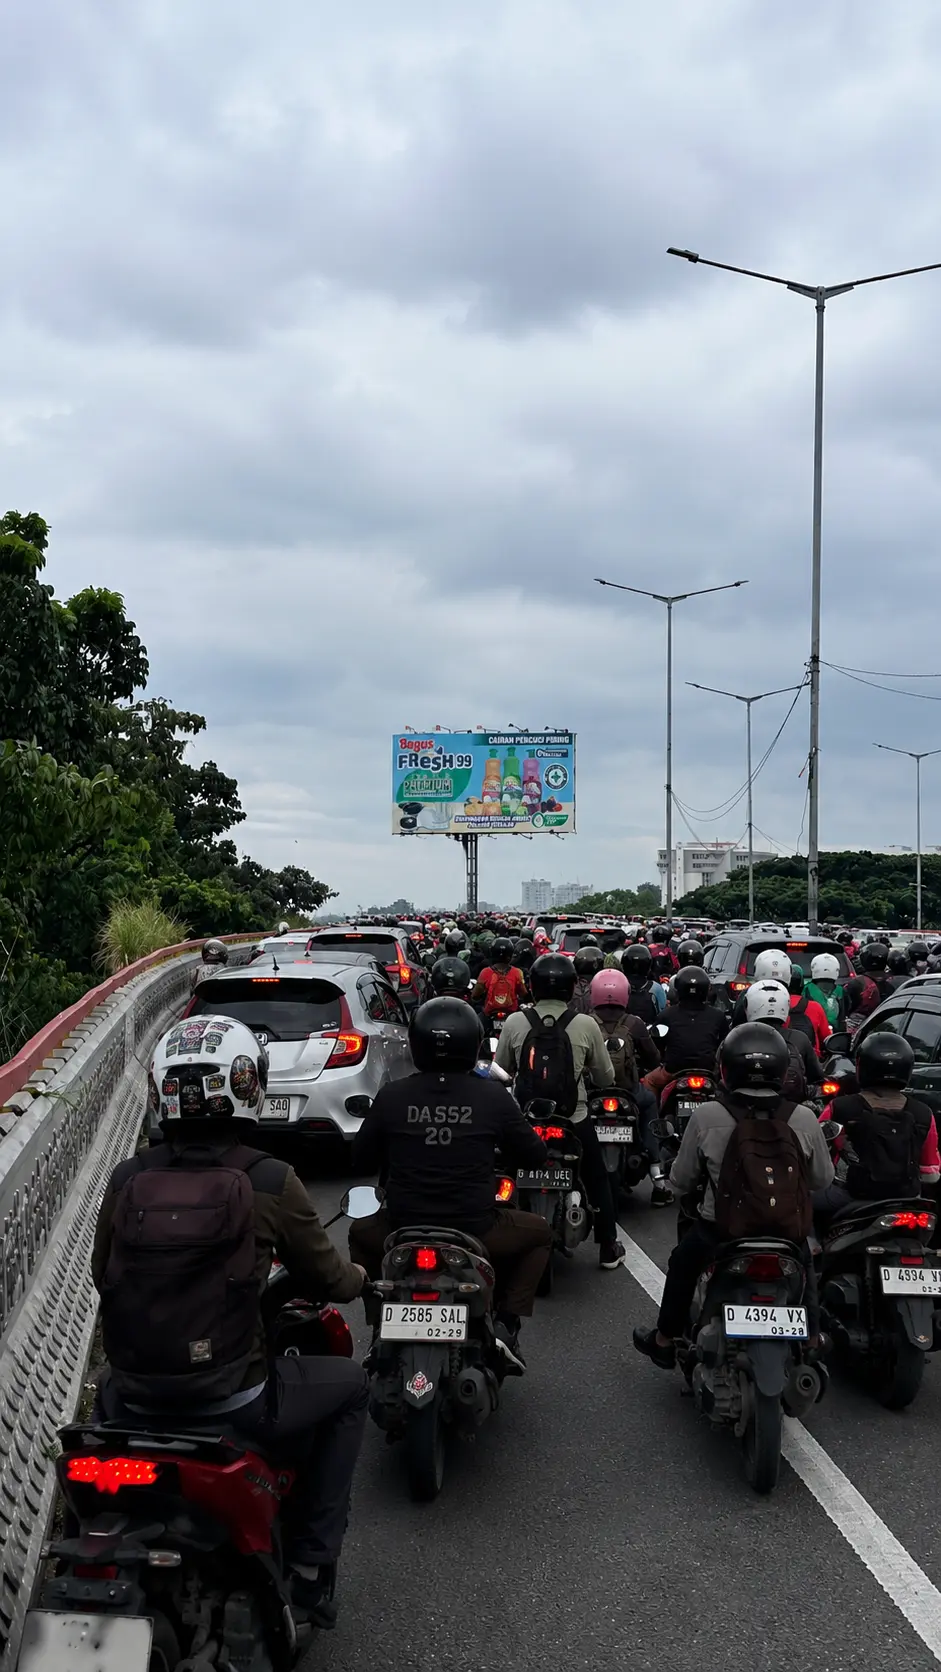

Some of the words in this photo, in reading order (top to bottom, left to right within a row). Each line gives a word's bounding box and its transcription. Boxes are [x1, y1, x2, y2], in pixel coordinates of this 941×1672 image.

[399, 738, 434, 752] Bagus
[457, 755, 472, 768] 99
[424, 1126, 452, 1145] 20
[883, 1268, 890, 1281] D
[385, 1307, 393, 1322] D
[401, 1307, 433, 1323] 2585
[440, 1308, 463, 1324] SAL
[727, 1307, 735, 1321] D
[745, 1307, 777, 1322] 4394
[787, 1309, 803, 1323] VX
[427, 1328, 462, 1338] 02-29
